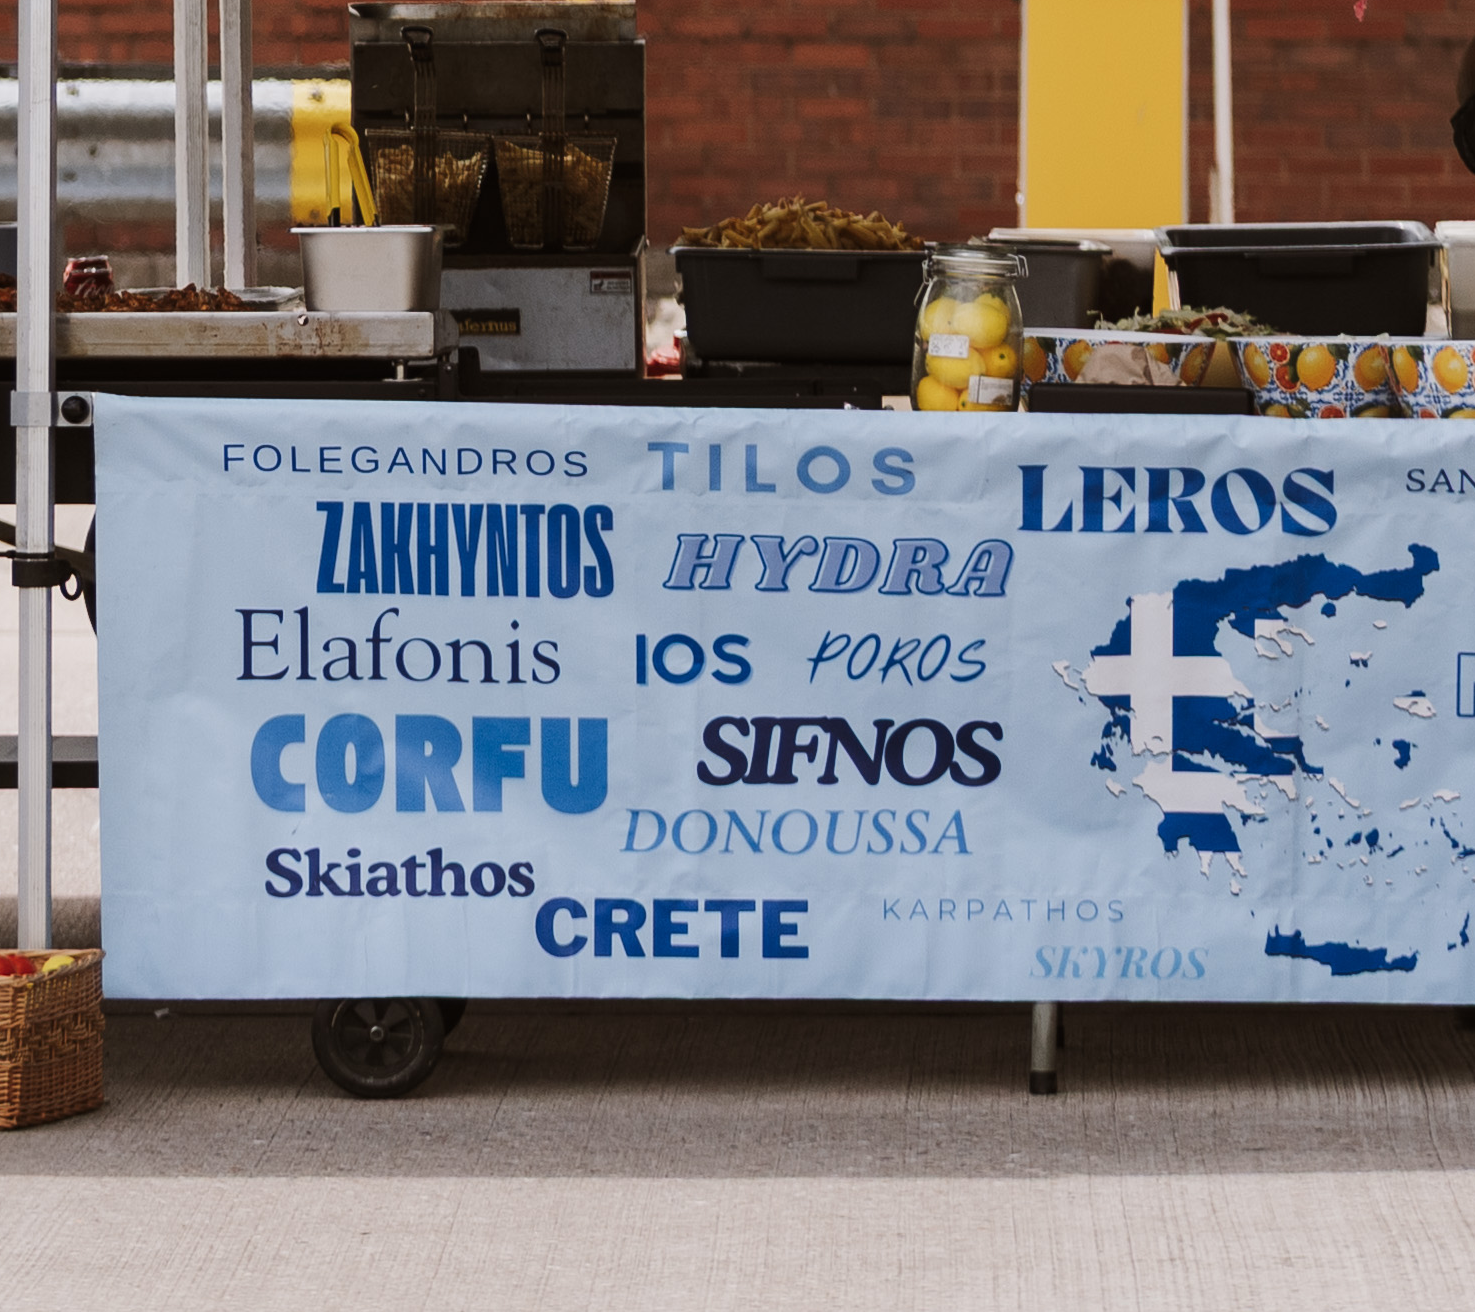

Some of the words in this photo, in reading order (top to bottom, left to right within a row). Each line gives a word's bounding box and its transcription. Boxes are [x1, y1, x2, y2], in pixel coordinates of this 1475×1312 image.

[223, 443, 589, 478] FOLEGANDROS
[646, 441, 916, 497] TILOS
[1017, 464, 1338, 539] LEROS
[315, 500, 615, 600] ZAKHYNTOS
[661, 532, 1014, 599] HYDRA
[236, 606, 561, 685] Elafonis
[635, 633, 753, 686] IOS
[807, 630, 987, 687] POROS
[250, 712, 609, 815] CORFU
[696, 715, 1004, 788] SIFNOS
[622, 808, 971, 856] DONOUSSA
[264, 847, 536, 899] Skiathos
[534, 897, 810, 960] CRETE
[882, 897, 1126, 924] KARPATHOS
[1030, 944, 1209, 981] SKYROS
